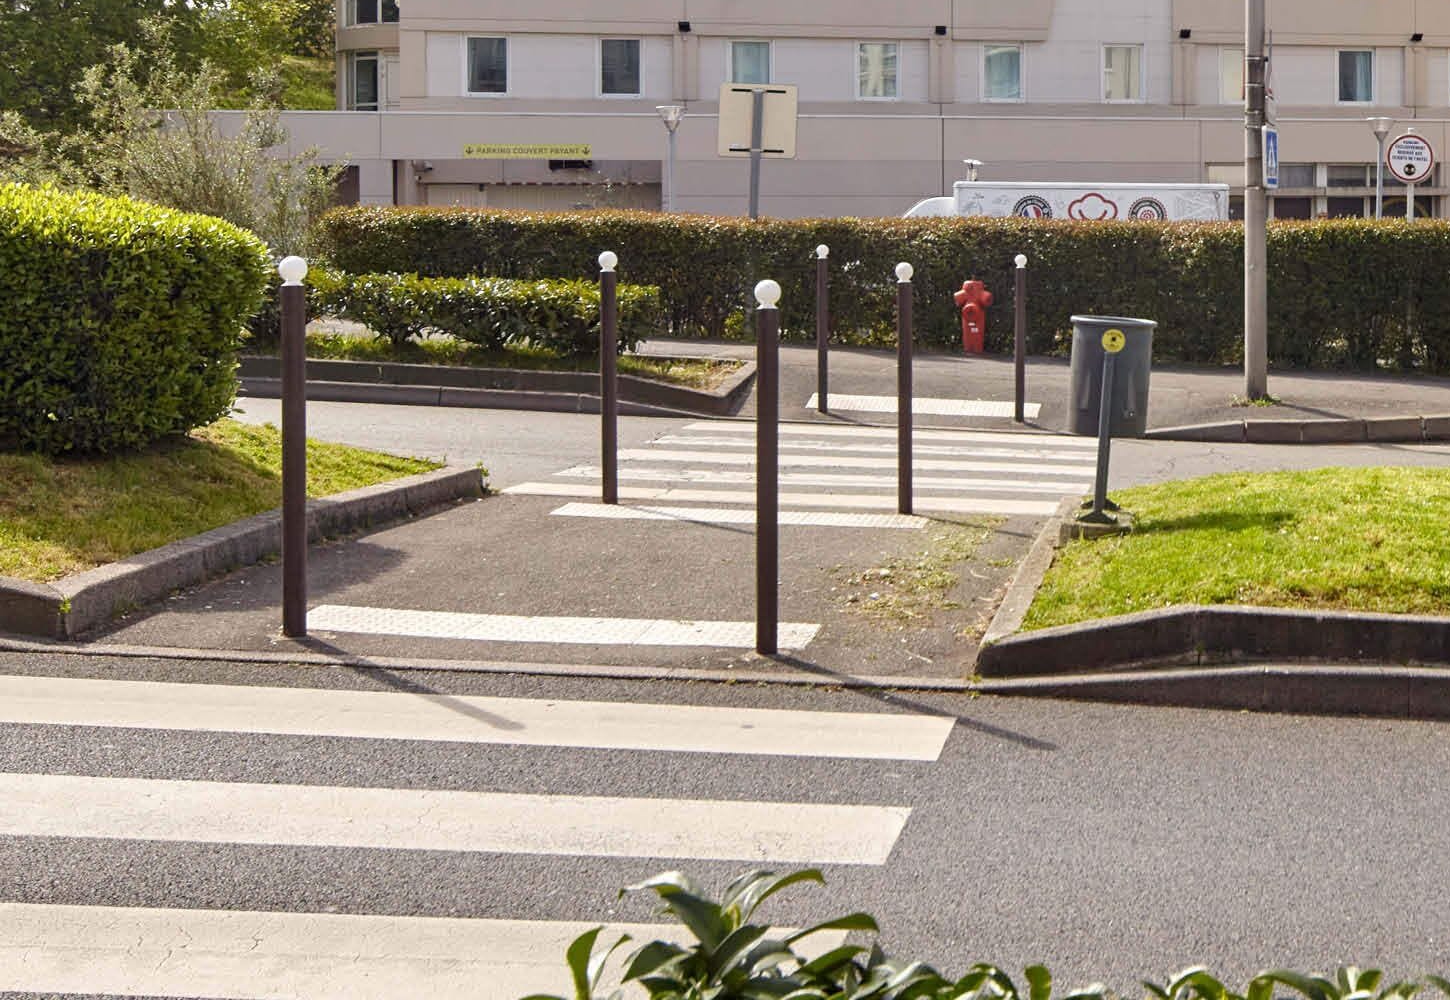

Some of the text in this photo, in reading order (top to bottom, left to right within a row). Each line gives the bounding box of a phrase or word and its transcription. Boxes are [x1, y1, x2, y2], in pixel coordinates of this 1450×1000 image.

[476, 146, 579, 154] PARKING COUVERT PAYANT
